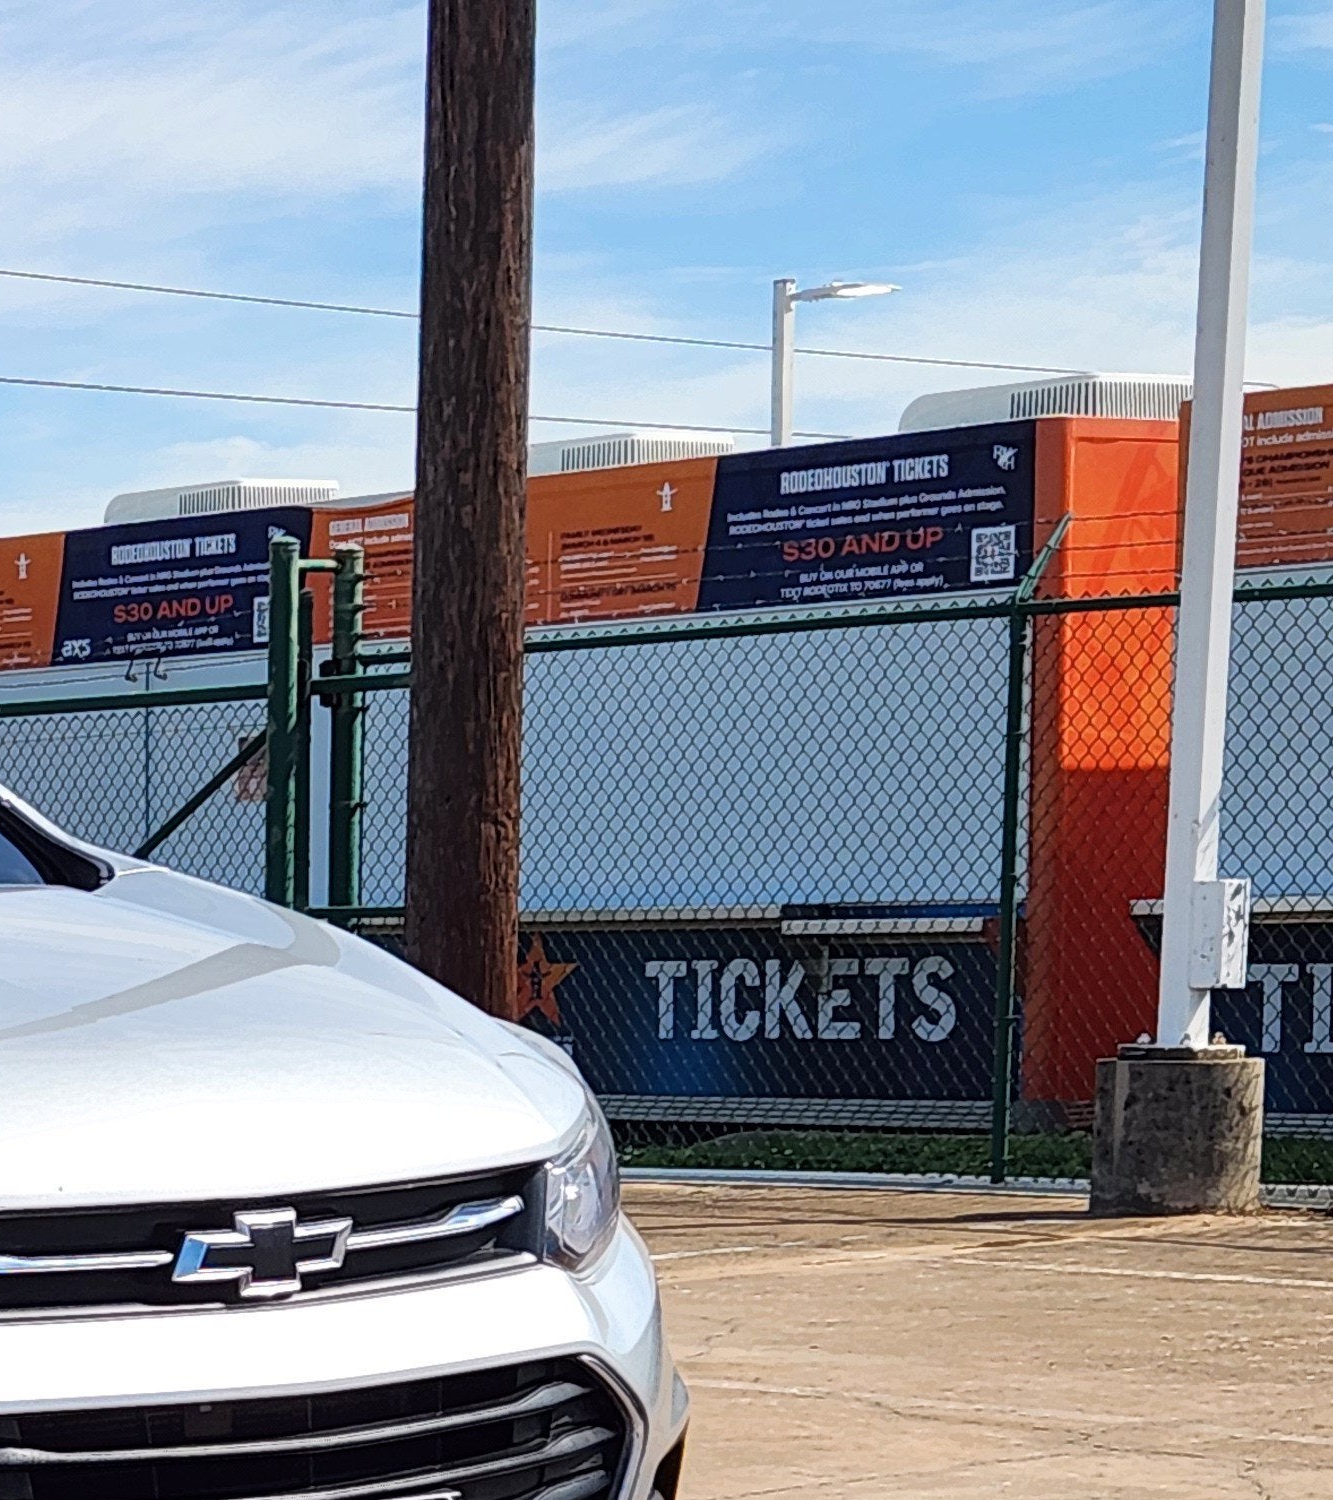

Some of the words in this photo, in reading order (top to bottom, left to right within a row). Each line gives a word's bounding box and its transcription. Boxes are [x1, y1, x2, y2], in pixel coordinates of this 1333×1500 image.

[1257, 433, 1294, 447] include
[893, 454, 949, 483] TICKETS
[841, 530, 900, 557] AND
[905, 525, 944, 551] UP
[156, 597, 201, 620] AND
[205, 594, 234, 615] UP
[644, 955, 956, 1043] TICKETS
